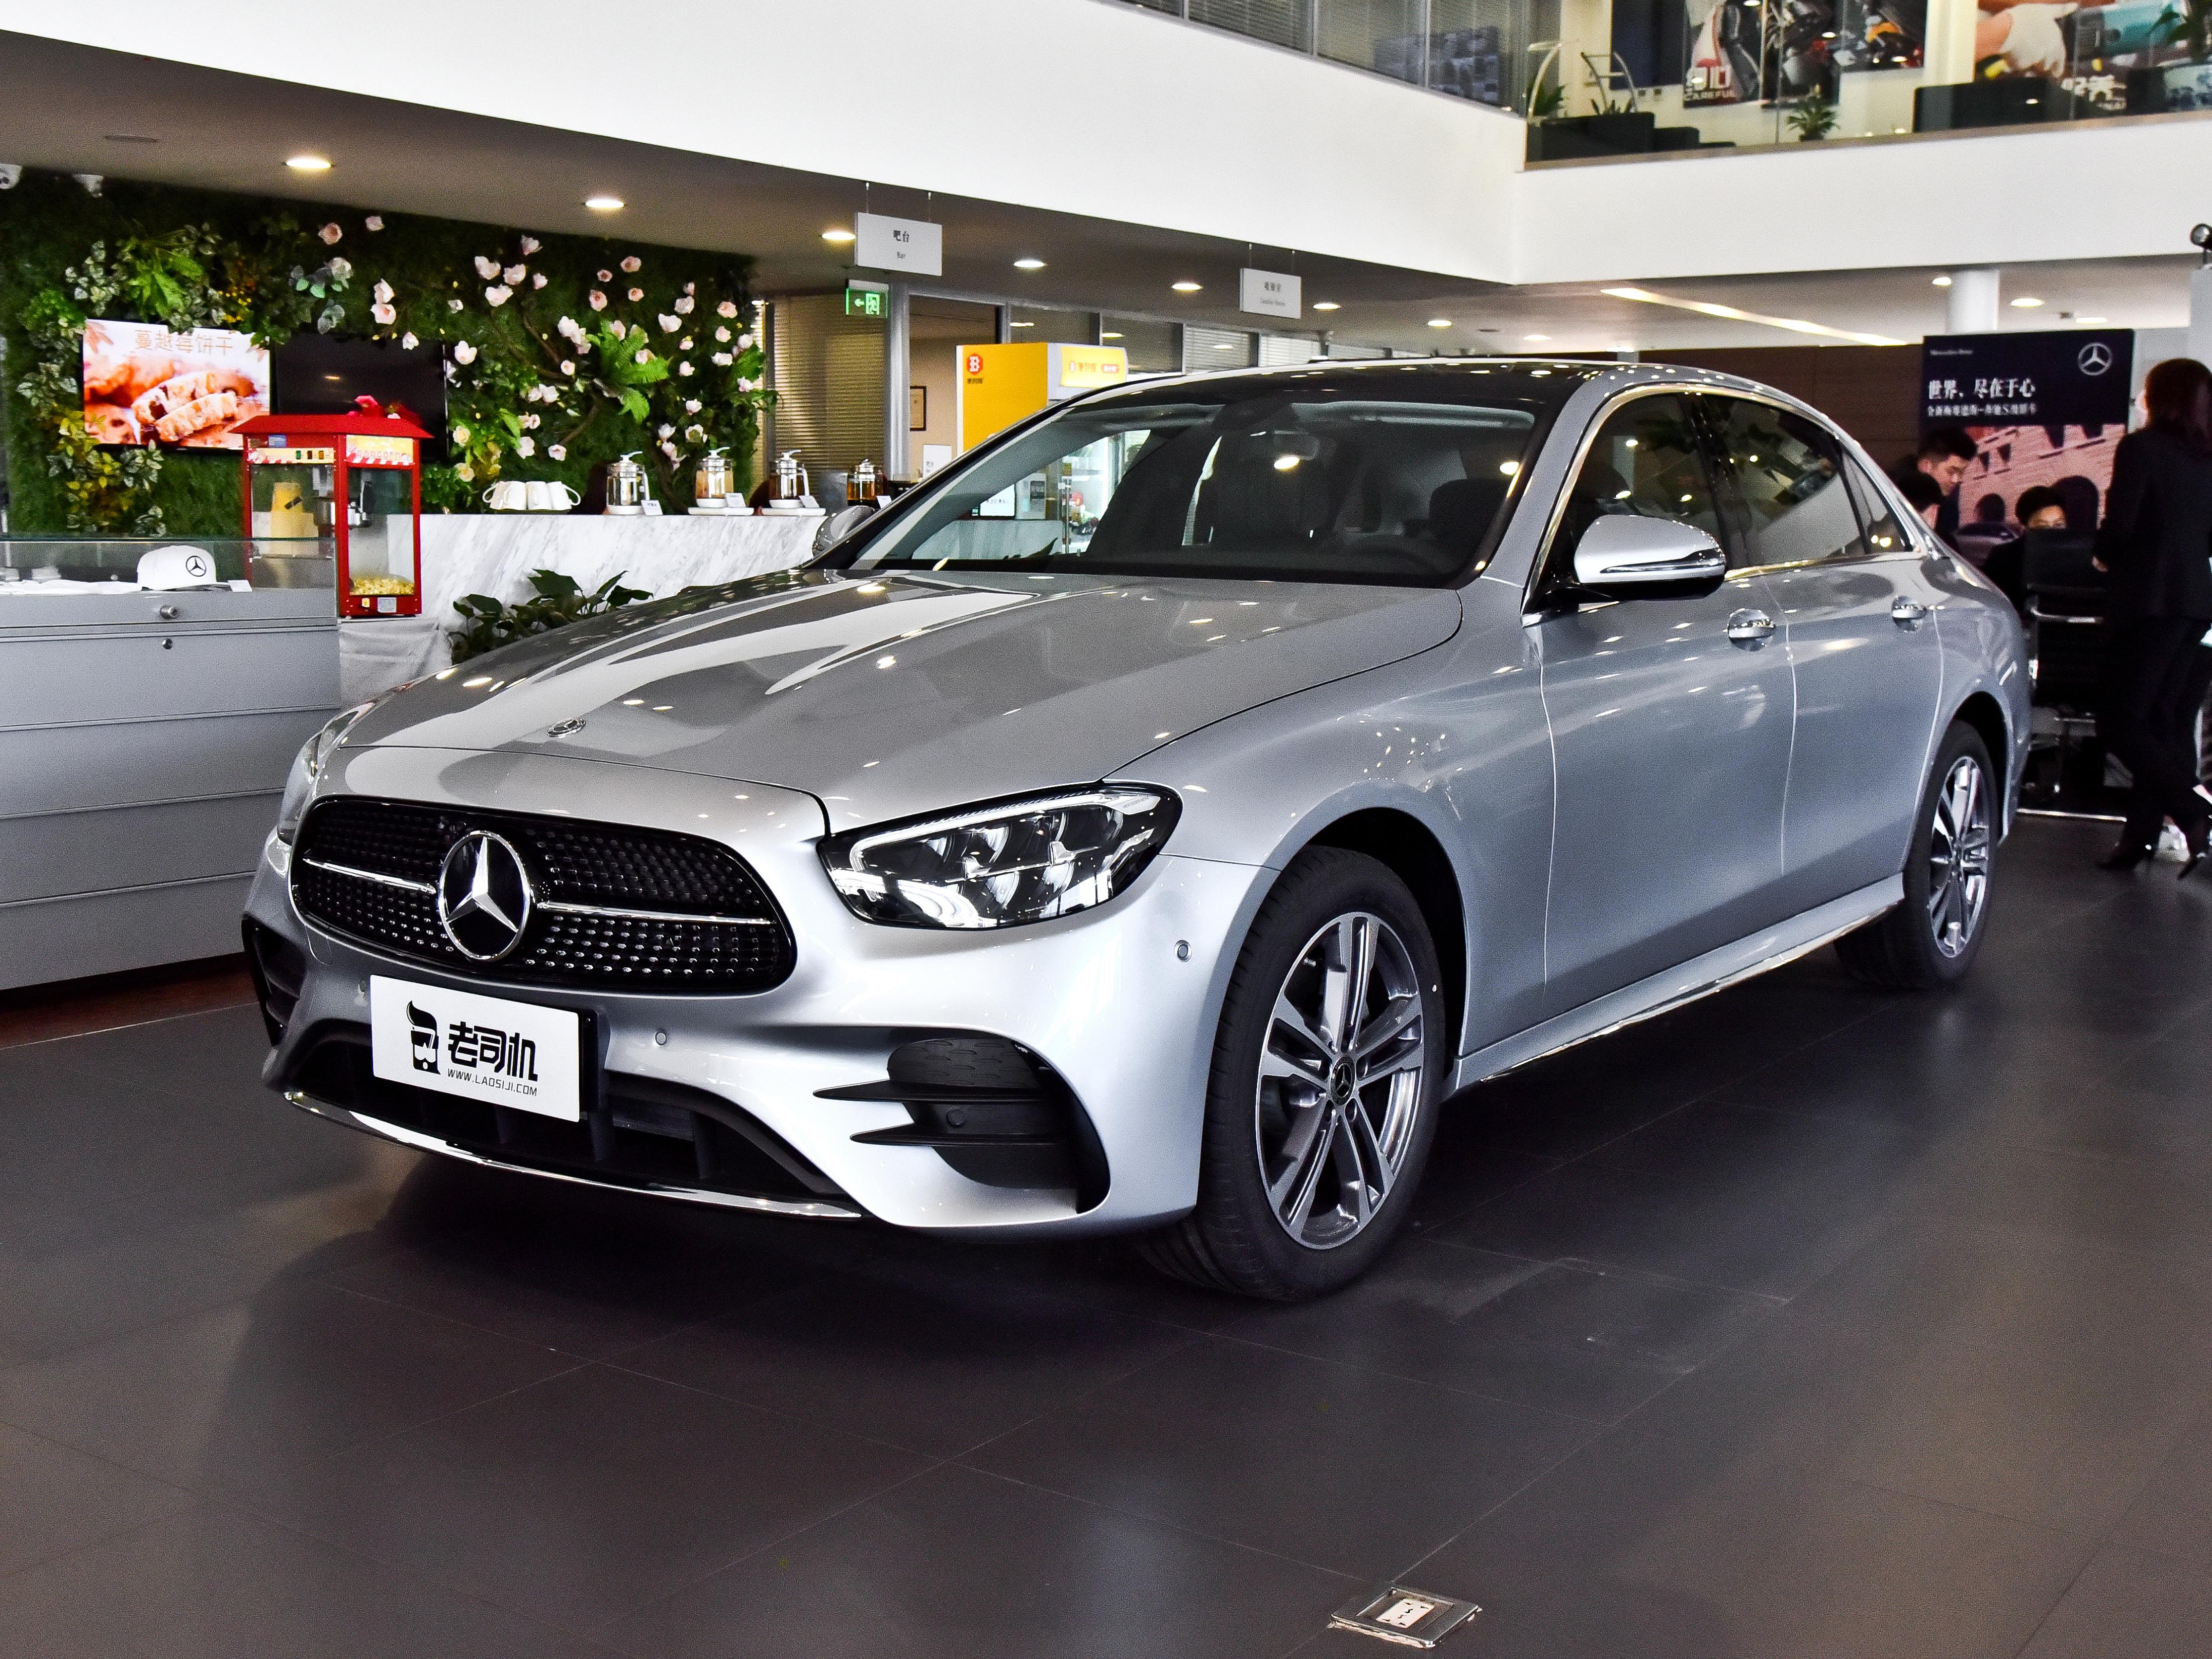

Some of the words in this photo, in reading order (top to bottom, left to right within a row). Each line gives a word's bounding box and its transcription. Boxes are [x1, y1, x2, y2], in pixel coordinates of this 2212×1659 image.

[893, 230, 909, 242] 吧台
[448, 1021, 538, 1081] 老司机
[447, 1068, 537, 1097] WWW.LAOSIJI.COM
